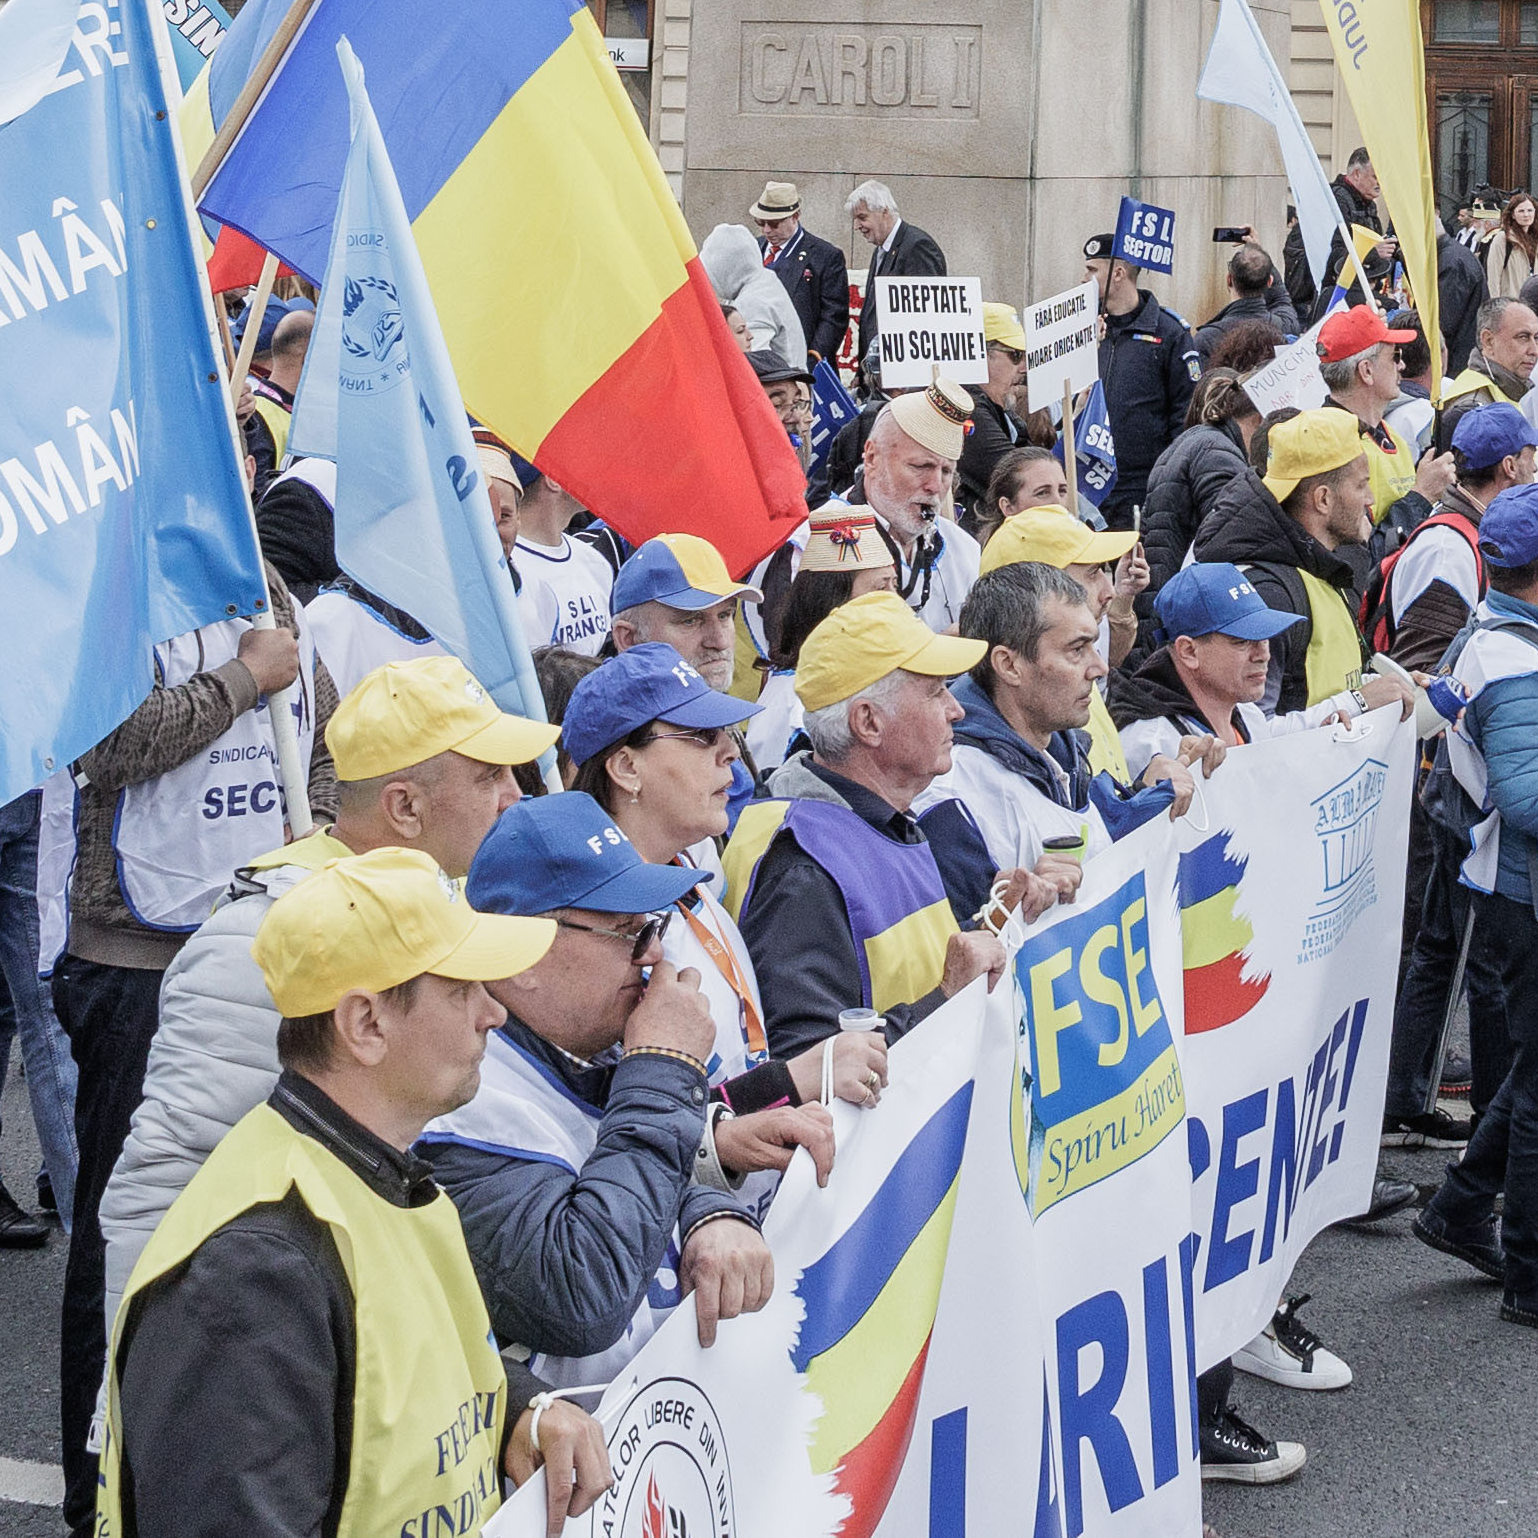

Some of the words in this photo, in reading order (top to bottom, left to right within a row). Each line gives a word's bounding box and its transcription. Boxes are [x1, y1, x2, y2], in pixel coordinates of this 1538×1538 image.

[751, 32, 939, 108] CAROL
[951, 35, 976, 108] I
[888, 284, 973, 317] DREPTATE,
[881, 332, 905, 363] NU
[908, 331, 977, 361] SCLAVIE
[1026, 345, 1054, 371] MOARE
[1053, 333, 1076, 360] ORICE
[1029, 896, 1163, 1099] FSE
[1047, 1117, 1130, 1196] Spiru
[1133, 1062, 1182, 1138] Haret
[644, 1398, 695, 1431] LIBERE
[698, 1421, 719, 1468] DIN
